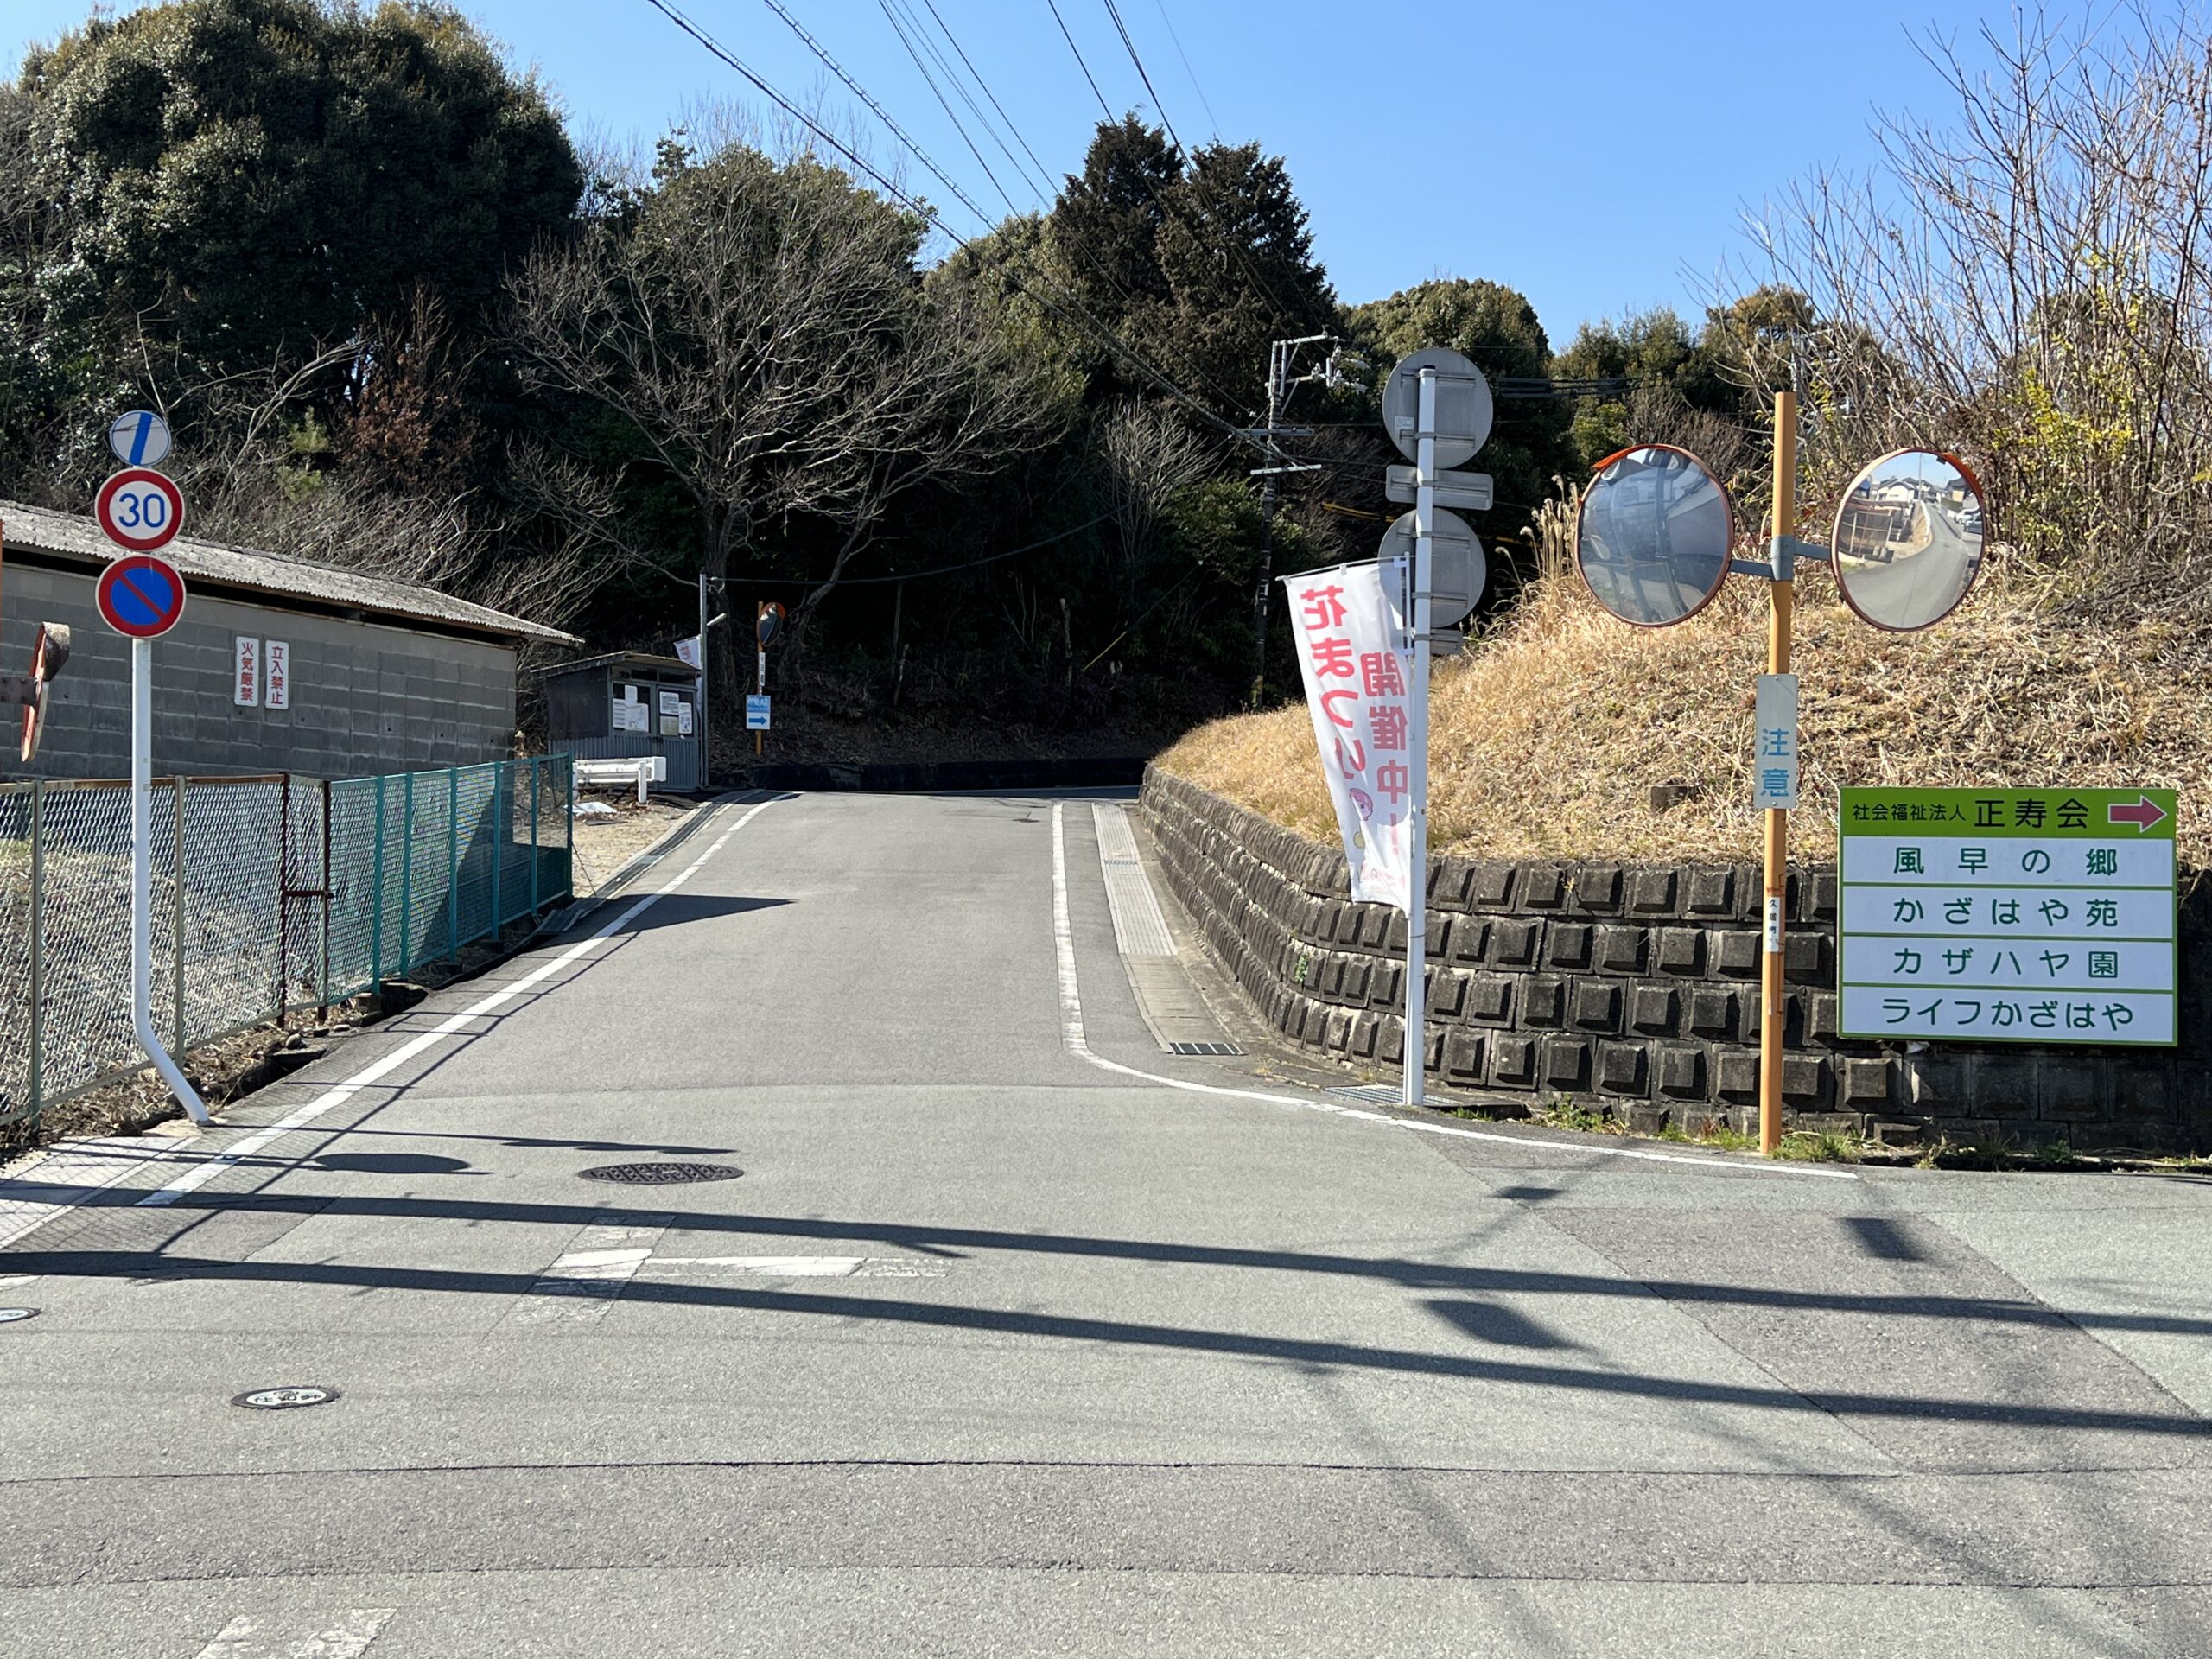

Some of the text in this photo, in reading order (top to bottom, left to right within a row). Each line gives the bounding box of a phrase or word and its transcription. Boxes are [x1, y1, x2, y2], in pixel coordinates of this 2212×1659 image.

[118, 493, 165, 528] 30
[240, 641, 255, 702] 火気厳禁
[270, 645, 284, 705] 立入禁止
[1760, 728, 1790, 798] 注意
[1852, 798, 2089, 830] 社会福祉法人 正寿会
[1892, 846, 2119, 876] 風早の郷
[1893, 896, 2119, 928] かざはや苑
[1892, 947, 2119, 979] カザハヤ園
[1881, 997, 2134, 1032] ライフかざはや
